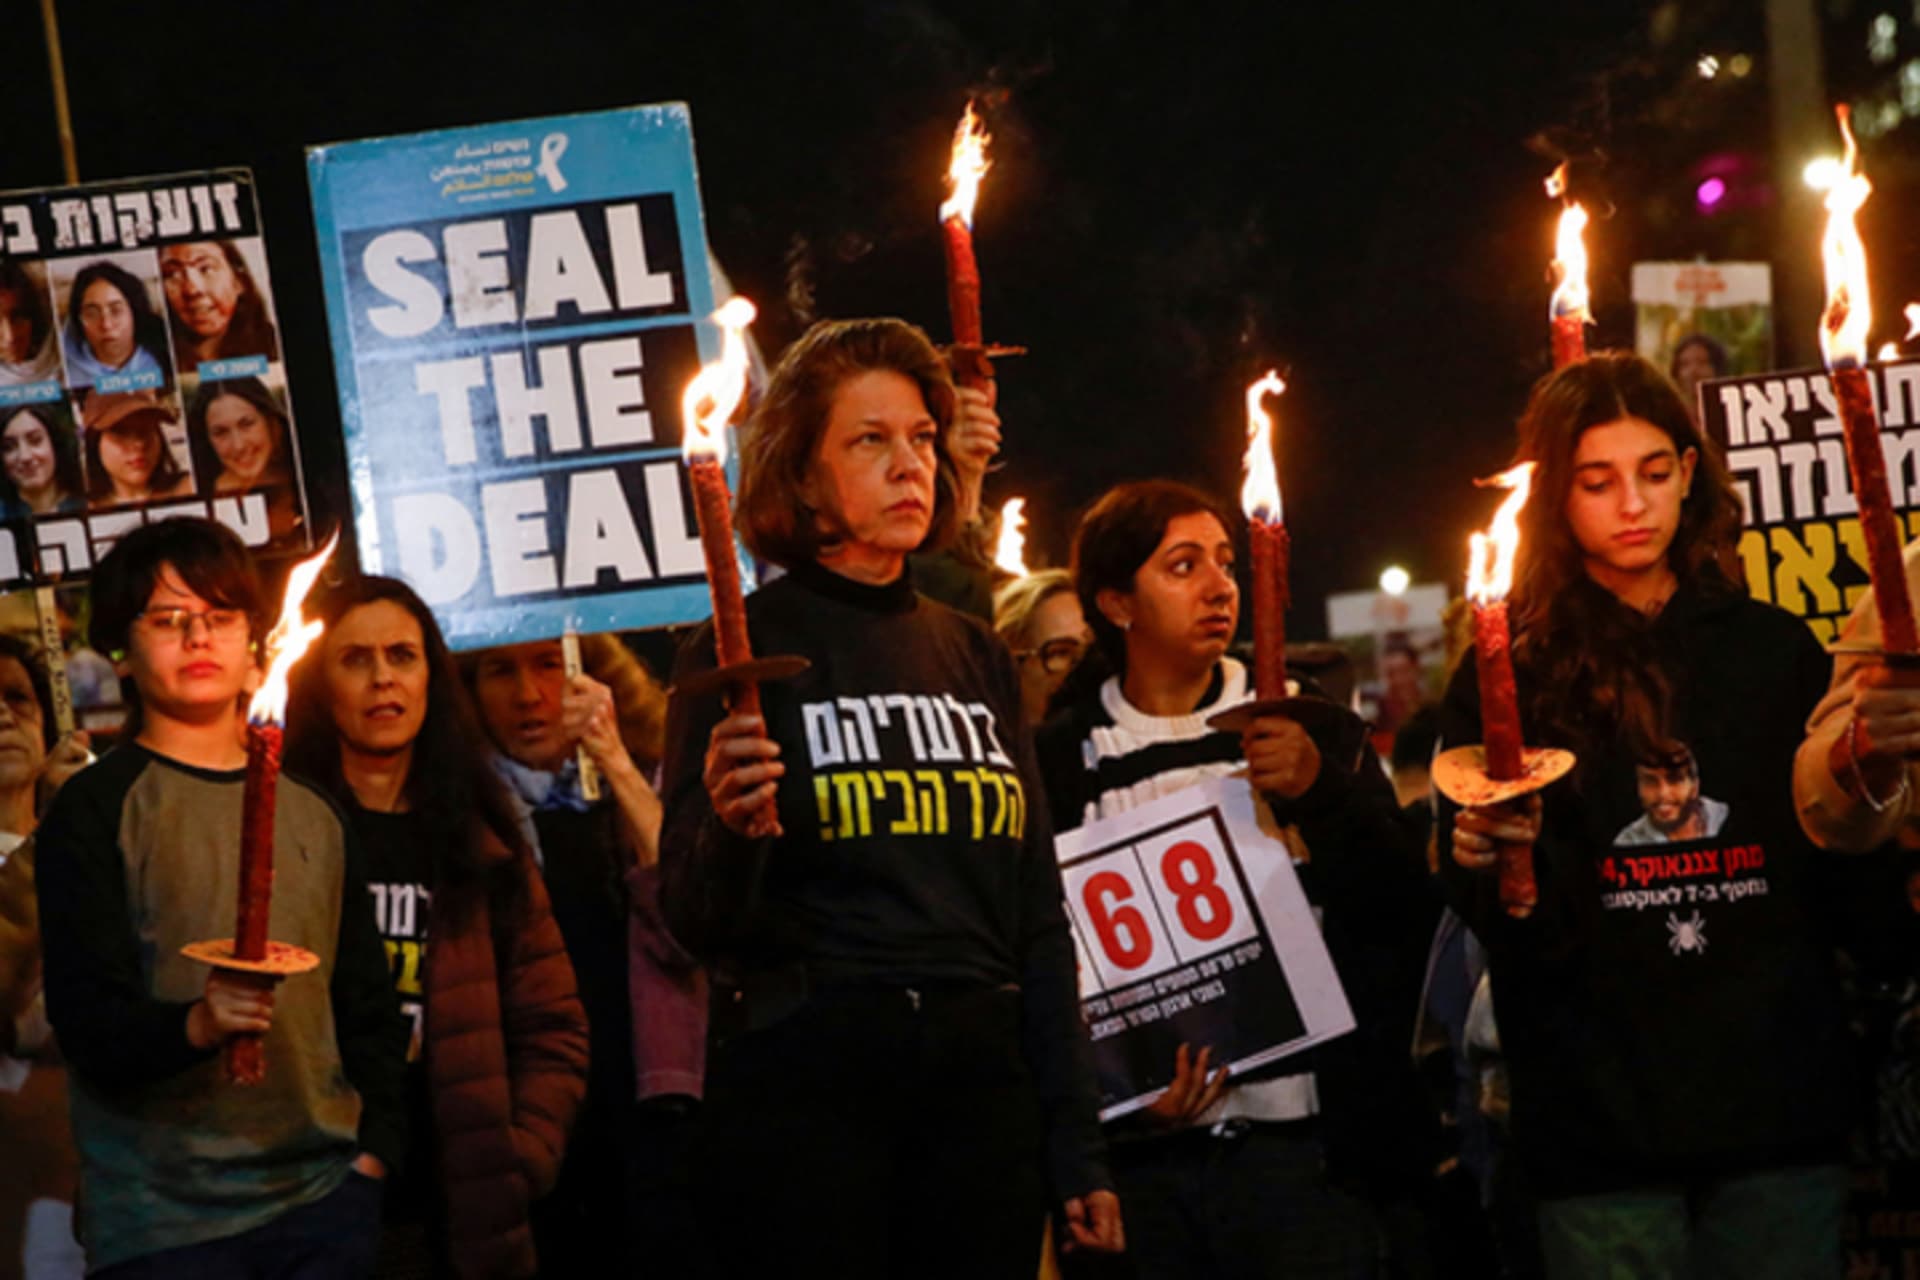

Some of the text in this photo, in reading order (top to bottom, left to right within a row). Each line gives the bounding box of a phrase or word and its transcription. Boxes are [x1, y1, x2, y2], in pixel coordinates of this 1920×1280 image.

[51, 182, 241, 249] זועקות
[362, 202, 675, 339] SEAL
[415, 337, 654, 466] THE
[1719, 363, 1920, 447] תציאו
[392, 462, 707, 604] DEAL
[802, 693, 1016, 769] בלעדיהם
[812, 767, 1027, 841] הלך הבית!
[1723, 844, 1765, 879] מתן
